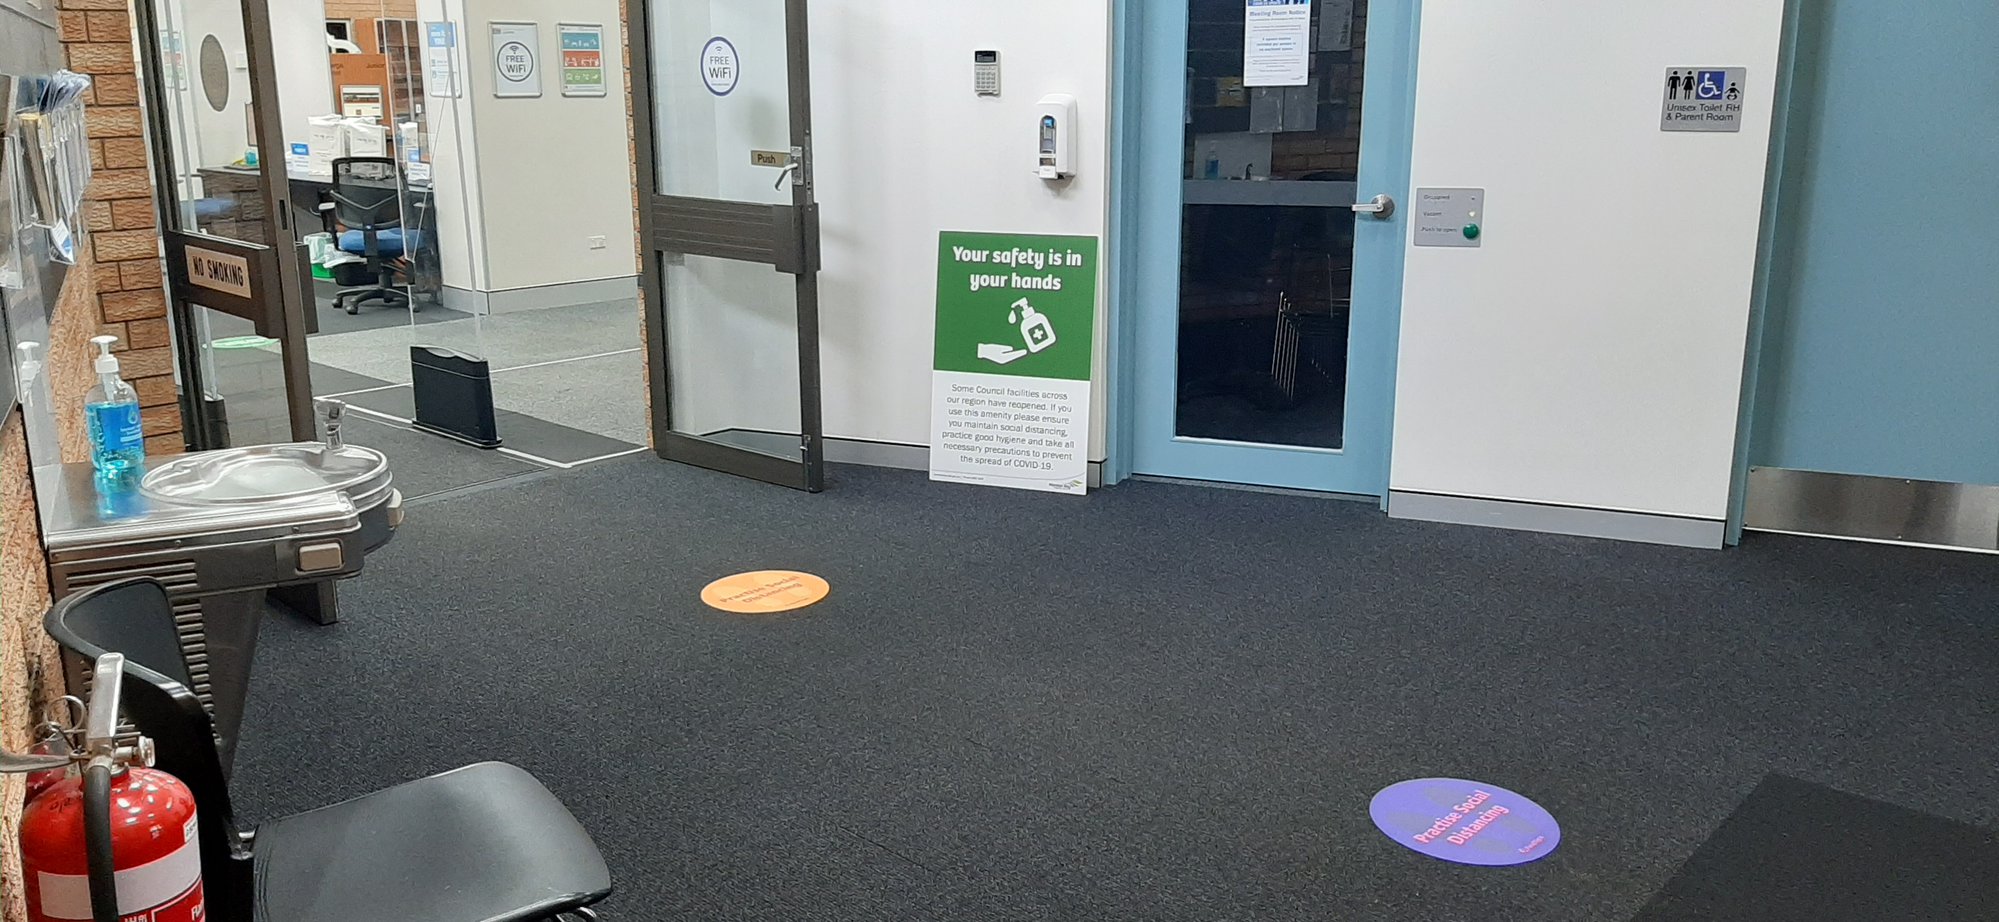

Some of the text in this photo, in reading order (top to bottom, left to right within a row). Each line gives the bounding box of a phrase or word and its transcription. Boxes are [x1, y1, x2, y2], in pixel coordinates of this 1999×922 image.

[505, 55, 524, 63] FREE
[710, 56, 730, 65] FREE
[708, 67, 732, 79] WiFi
[1666, 104, 1740, 112] Unisex Toilet RH
[1666, 112, 1734, 121] & Parent Room
[757, 154, 776, 164] Push
[952, 246, 1082, 270] Your safety is in
[192, 255, 244, 287] NO SMOKING
[970, 272, 1062, 292] your hands
[952, 384, 1068, 400] Some Council facilities across
[962, 397, 986, 407] region
[988, 398, 1006, 407] have
[1008, 401, 1048, 412] reopened.
[1050, 403, 1056, 412] If
[1058, 405, 1072, 414] you
[964, 408, 979, 417] this
[980, 410, 1012, 421] amenity
[1014, 412, 1040, 422] please
[1042, 416, 1070, 425] ensure
[948, 420, 962, 428] you
[964, 420, 999, 430] maintain
[1000, 422, 1024, 432] social
[942, 430, 1075, 448] practice good hygiene and take all
[943, 442, 1072, 462] necessary precautions to prevent
[960, 454, 973, 464] the
[974, 456, 1002, 466] spread
[1004, 458, 1012, 467] of
[1412, 789, 1492, 844] Practise Social
[1446, 804, 1510, 846] Distancing
